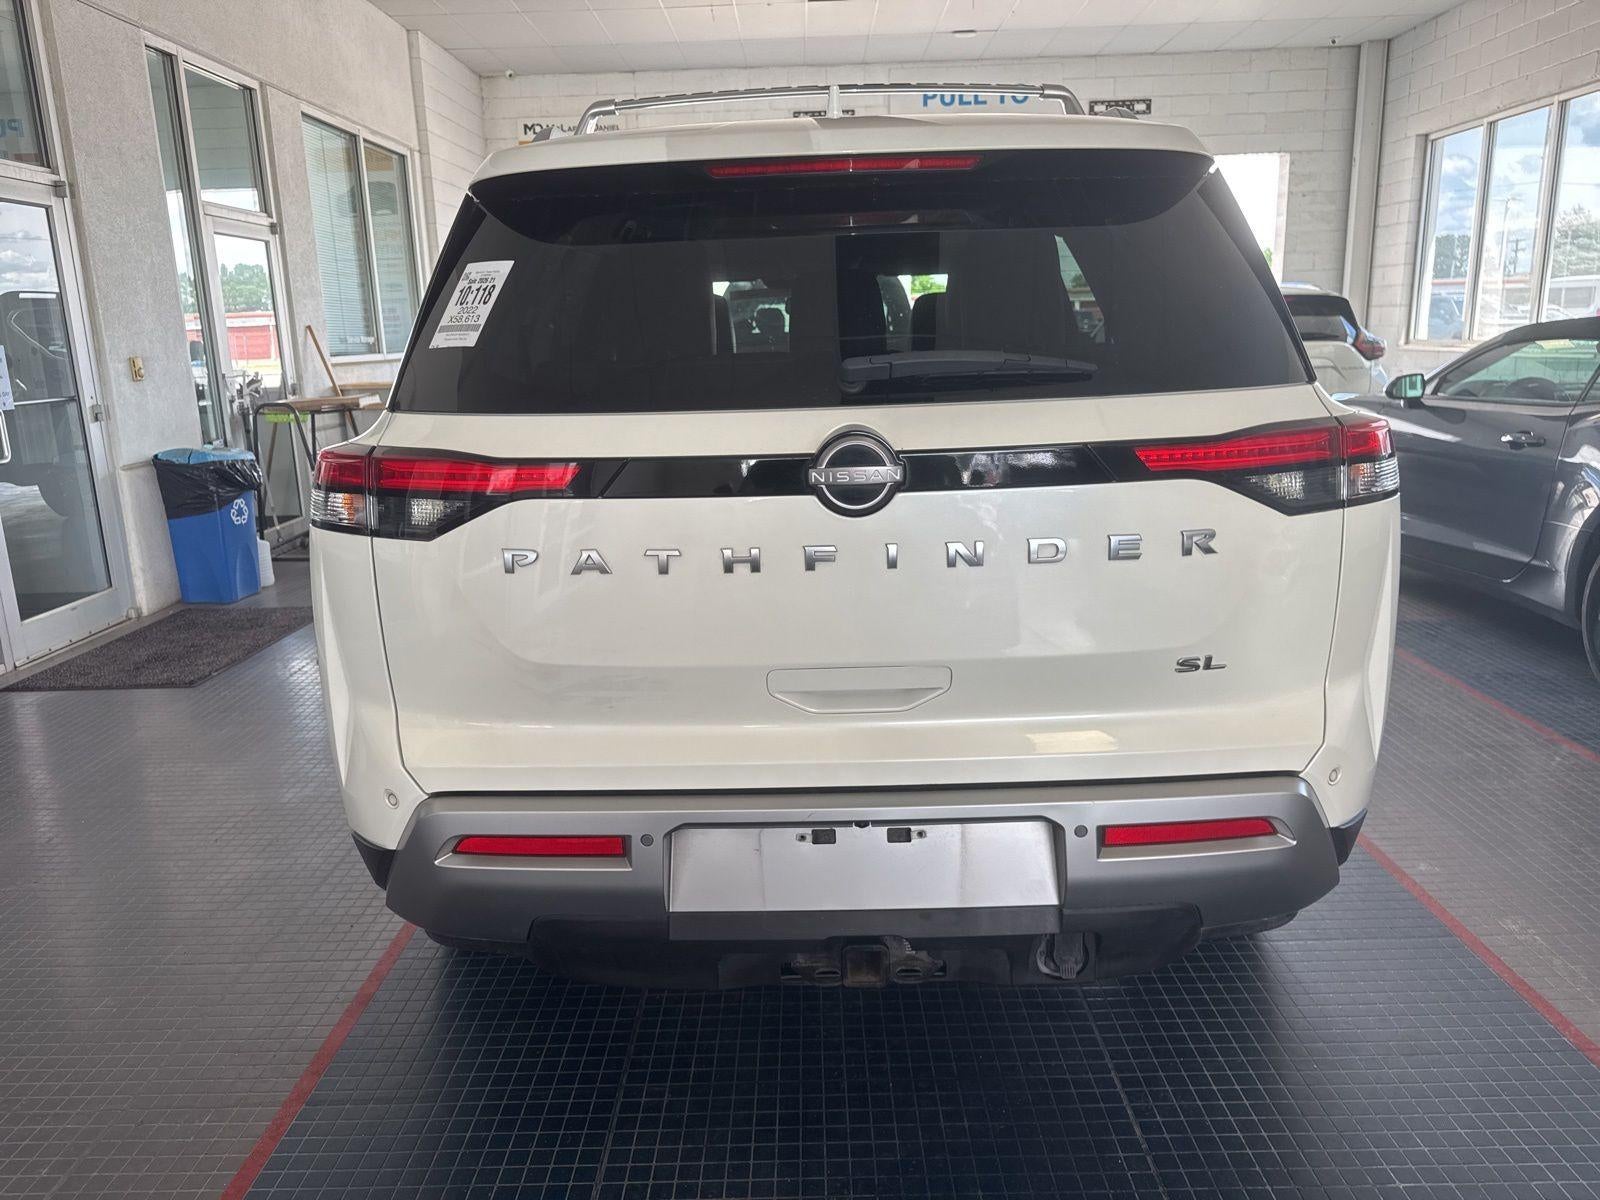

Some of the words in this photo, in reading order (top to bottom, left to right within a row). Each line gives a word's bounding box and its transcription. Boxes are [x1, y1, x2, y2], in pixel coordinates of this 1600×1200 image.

[923, 93, 987, 107] PULL
[455, 284, 496, 306] 10:118
[457, 306, 479, 315] 2022
[811, 469, 900, 482] NISSAN
[501, 528, 1219, 576] PATHFINDER
[1174, 654, 1227, 673] SL
